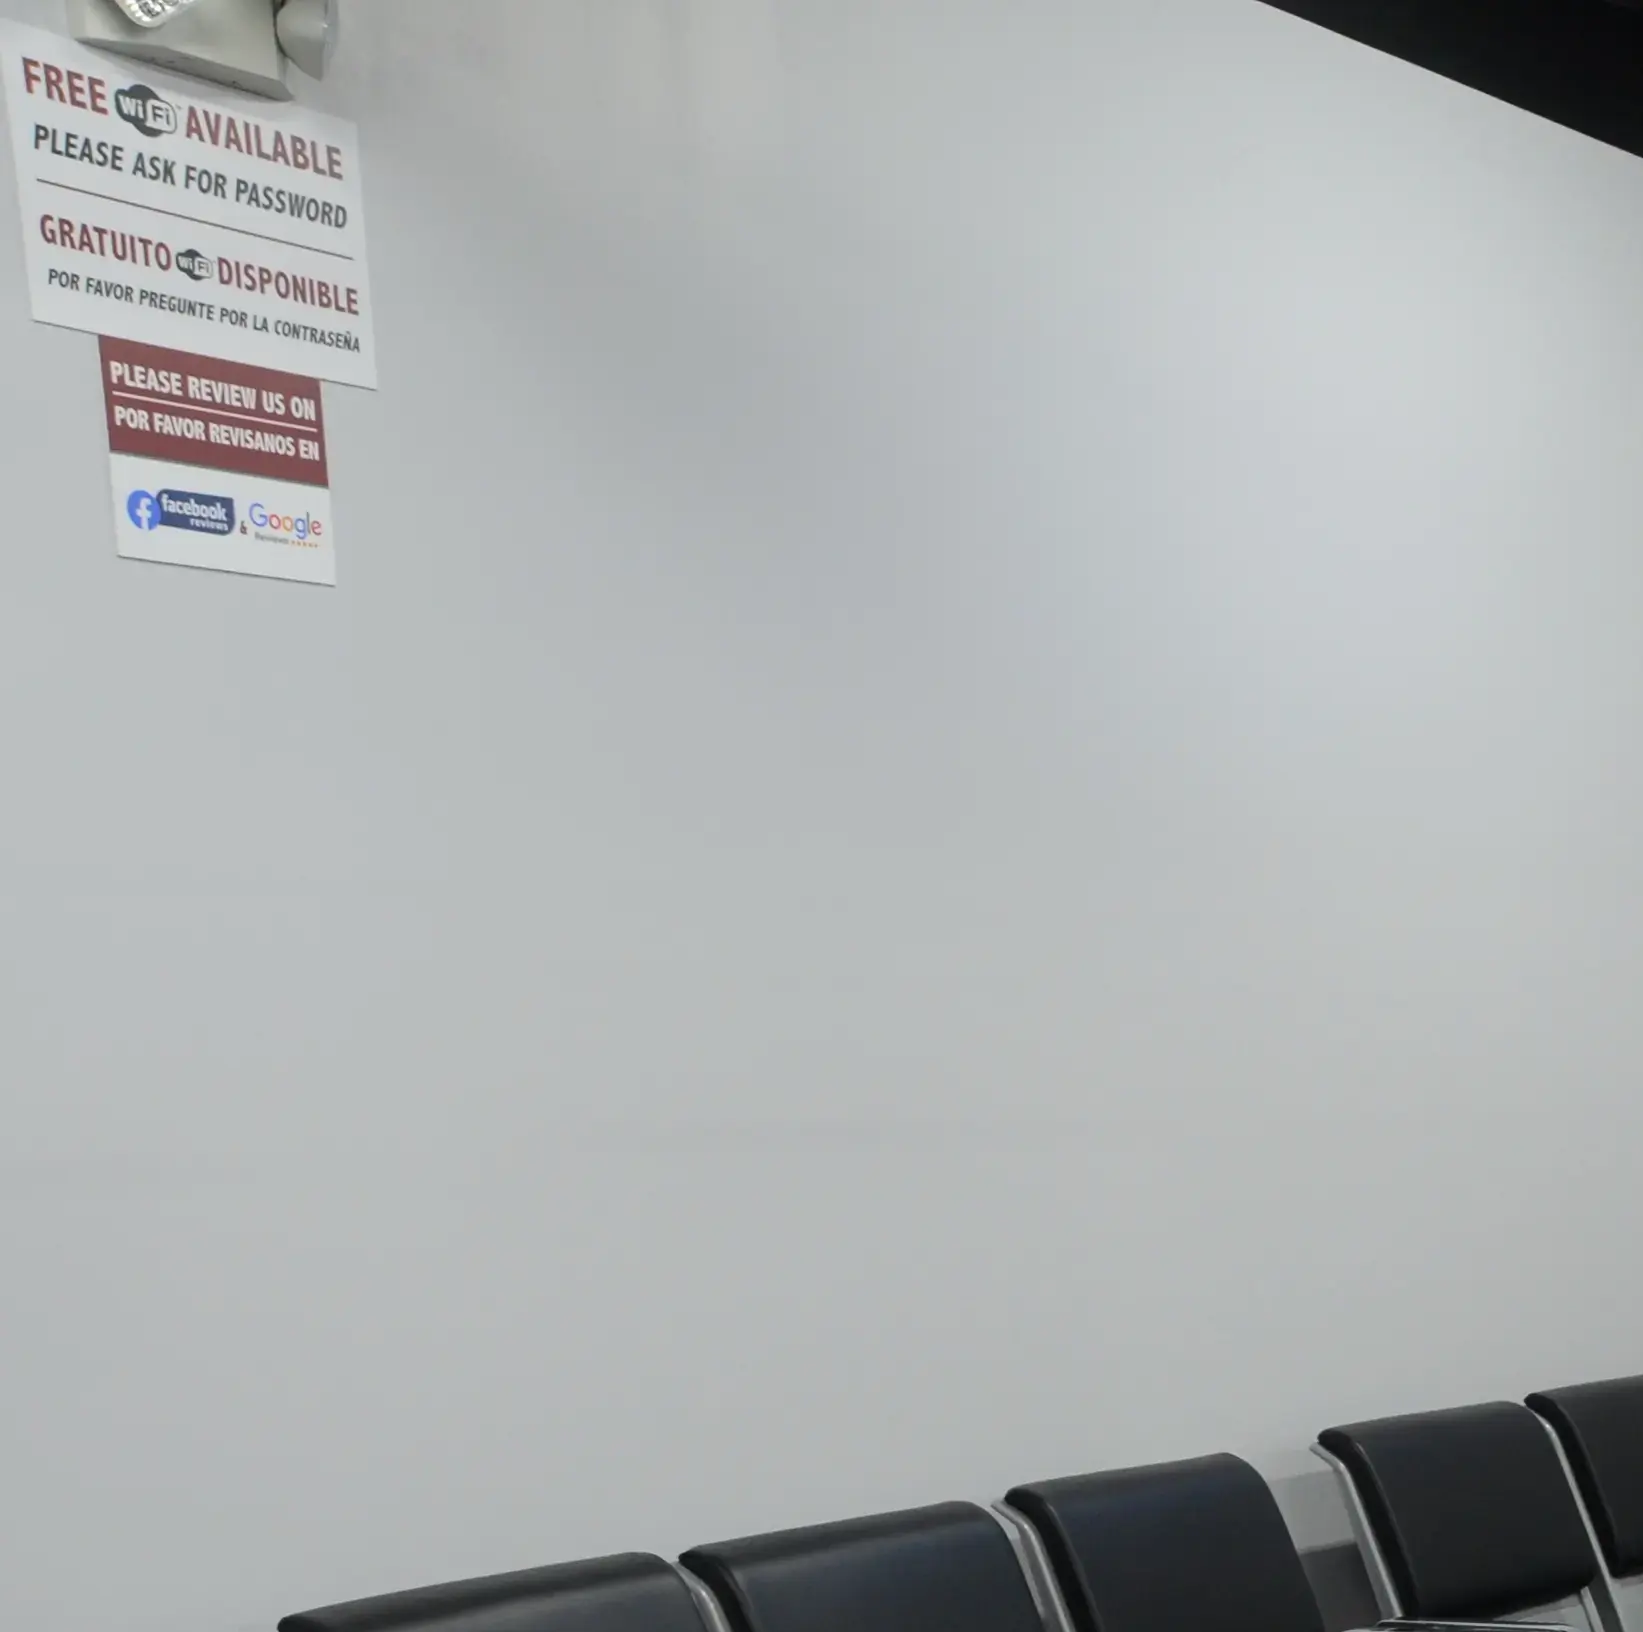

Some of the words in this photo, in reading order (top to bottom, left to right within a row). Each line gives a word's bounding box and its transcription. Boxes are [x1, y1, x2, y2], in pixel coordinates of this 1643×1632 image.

[22, 56, 109, 116] FREE
[185, 105, 345, 181] AVAILABLE
[33, 123, 124, 172] PLEASE
[132, 151, 177, 186] ASK
[184, 164, 227, 199] FOR
[235, 178, 348, 230] PASSWORD
[39, 213, 173, 272] GRATUITO
[217, 256, 360, 316] DISPONIBLE
[48, 268, 80, 292] POR
[85, 276, 134, 303] FAVOR
[139, 289, 215, 321] PREGUNTE
[220, 307, 248, 329] POR
[253, 316, 270, 334] LA
[274, 319, 361, 354] CONTRASEÑA
[109, 360, 184, 397] PLEASE
[187, 375, 257, 410] REVIEW
[261, 390, 286, 416] US
[290, 396, 316, 422] ON
[113, 404, 150, 432] POR
[153, 412, 206, 442] FAVOR
[209, 423, 295, 457] REVISANOS
[298, 439, 320, 462] EN
[160, 493, 228, 522] facebook
[248, 502, 323, 540] Google
[189, 517, 229, 532] reviews
